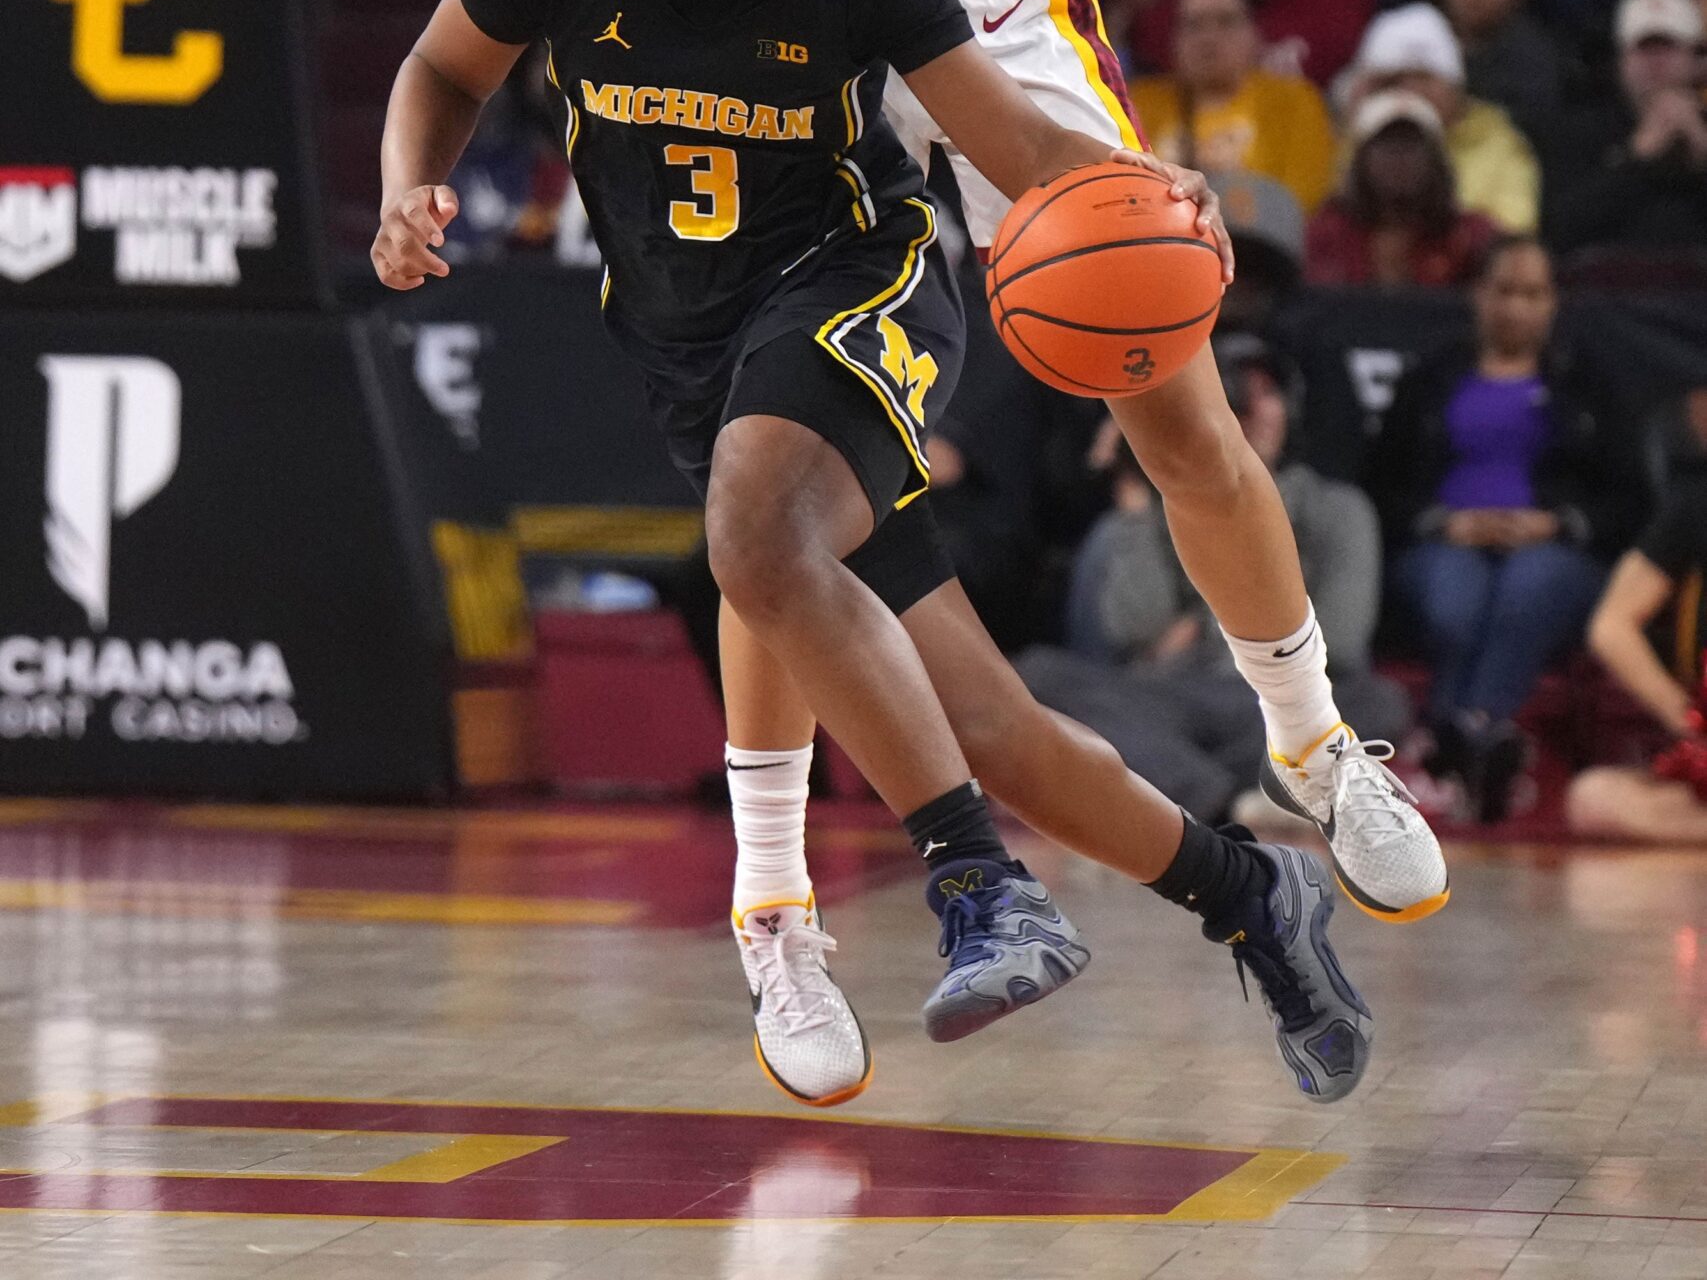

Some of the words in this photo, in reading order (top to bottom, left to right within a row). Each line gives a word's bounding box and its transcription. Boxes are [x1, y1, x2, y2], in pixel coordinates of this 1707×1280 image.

[580, 79, 814, 140] MICHIGAN
[80, 164, 278, 248] MUSCLE
[663, 143, 740, 242] 3
[114, 225, 241, 287] MILK
[876, 312, 940, 428] M
[0, 635, 295, 702] CHANGA
